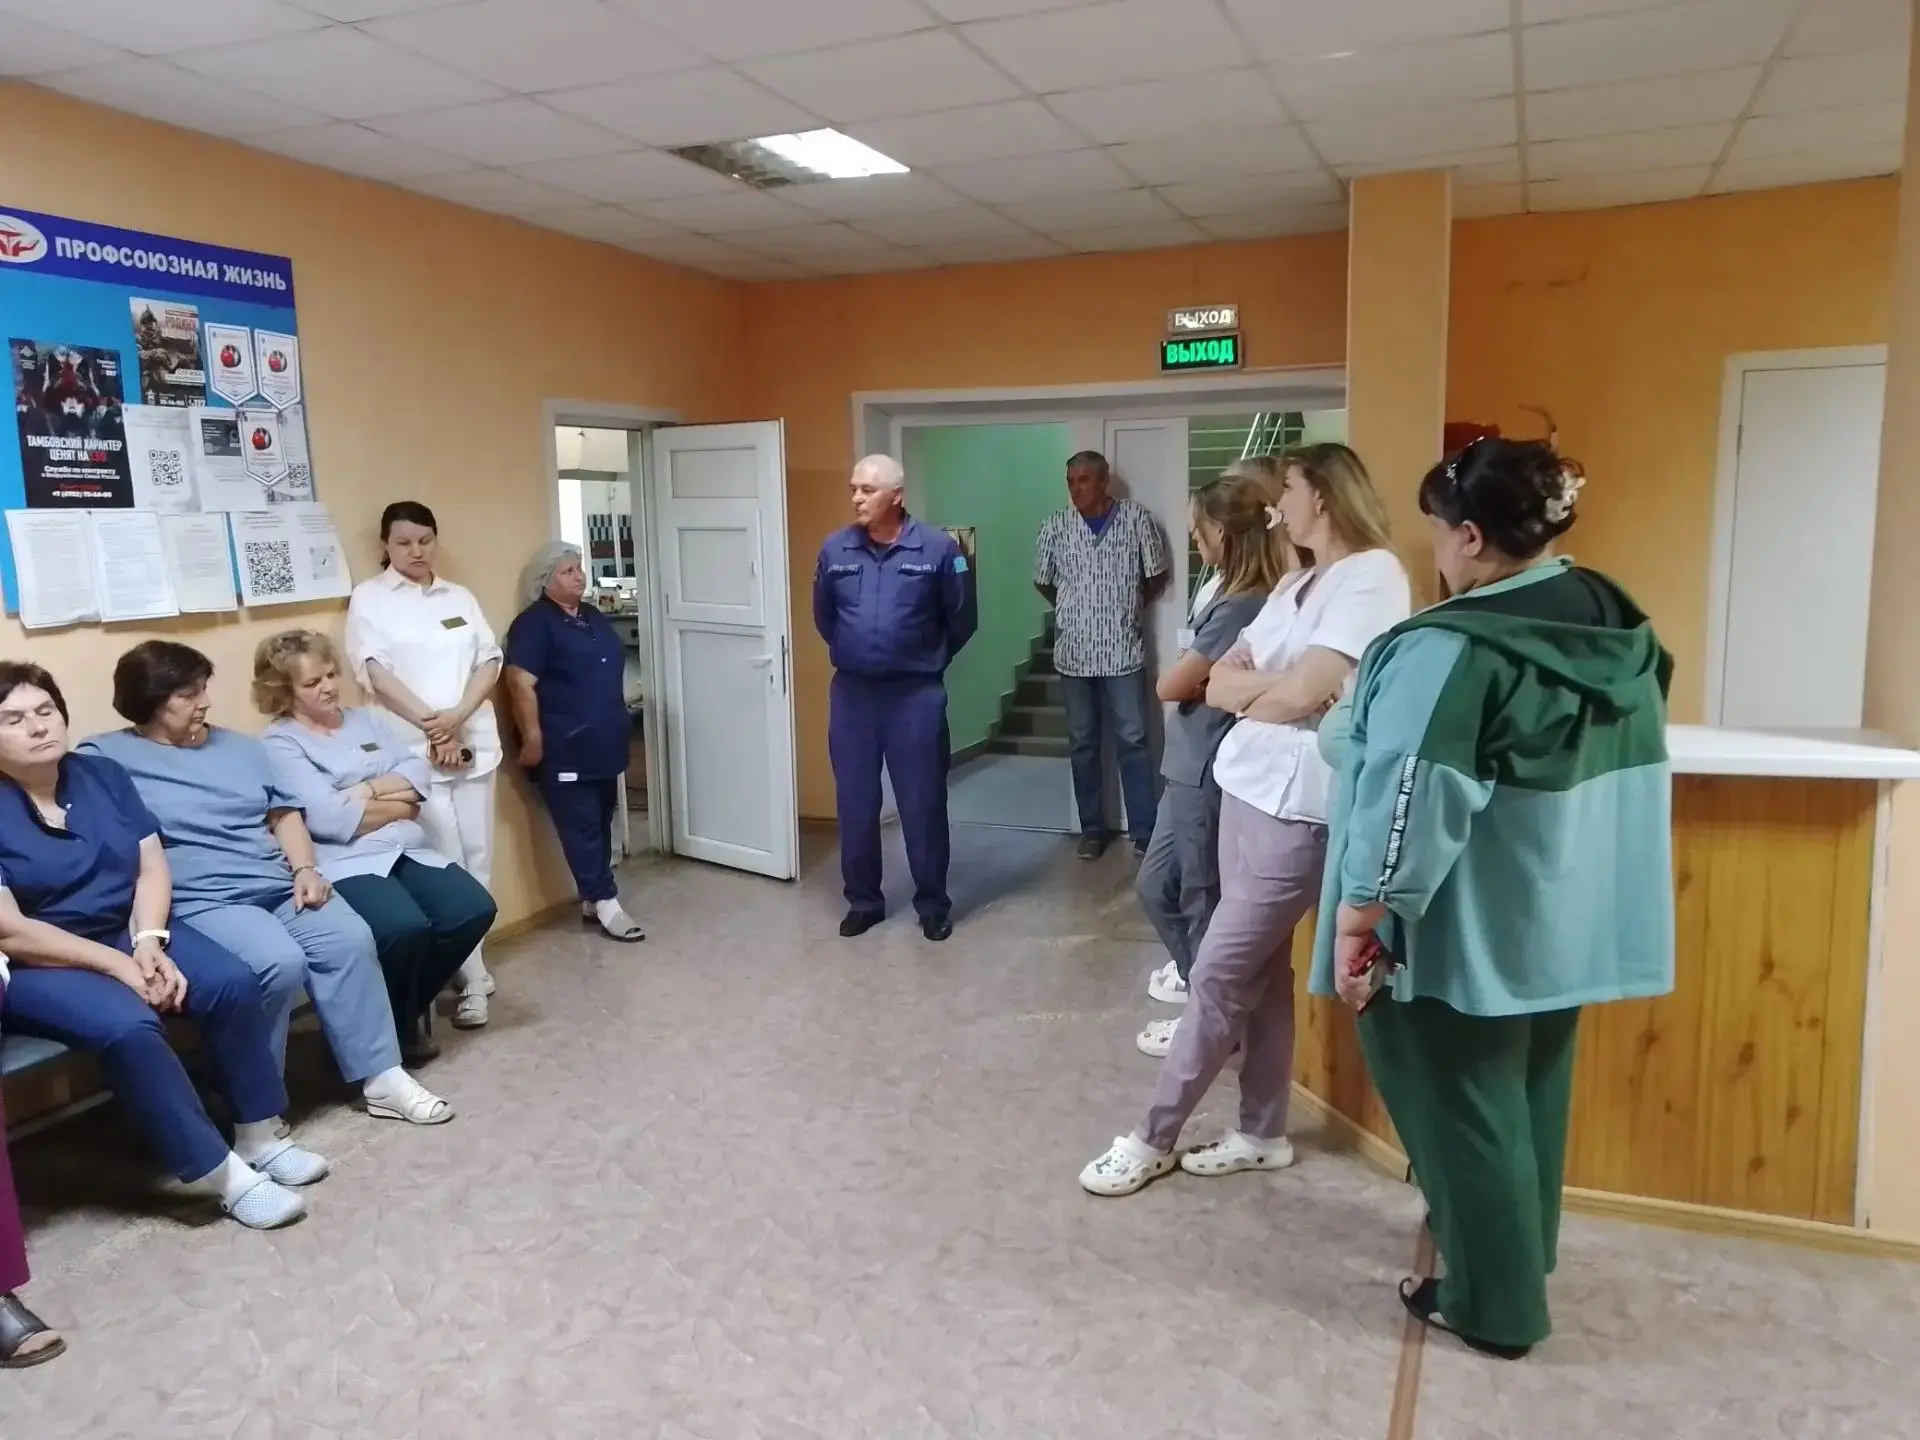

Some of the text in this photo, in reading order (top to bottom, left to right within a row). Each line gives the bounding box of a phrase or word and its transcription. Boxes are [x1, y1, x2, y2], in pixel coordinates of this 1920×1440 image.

[55, 236, 287, 291] ПРОФСОЮЗНАЯ ЖИЗНЬ
[1175, 309, 1232, 327] ВЫХОД
[1166, 339, 1233, 363] ВЫХОД
[26, 435, 122, 451] ТАМБОВСКИЙ ХАРАКТЕР
[50, 449, 75, 461] ЦЕНЯТ
[77, 450, 89, 461] НА
[1394, 793, 1409, 830] FASHION
